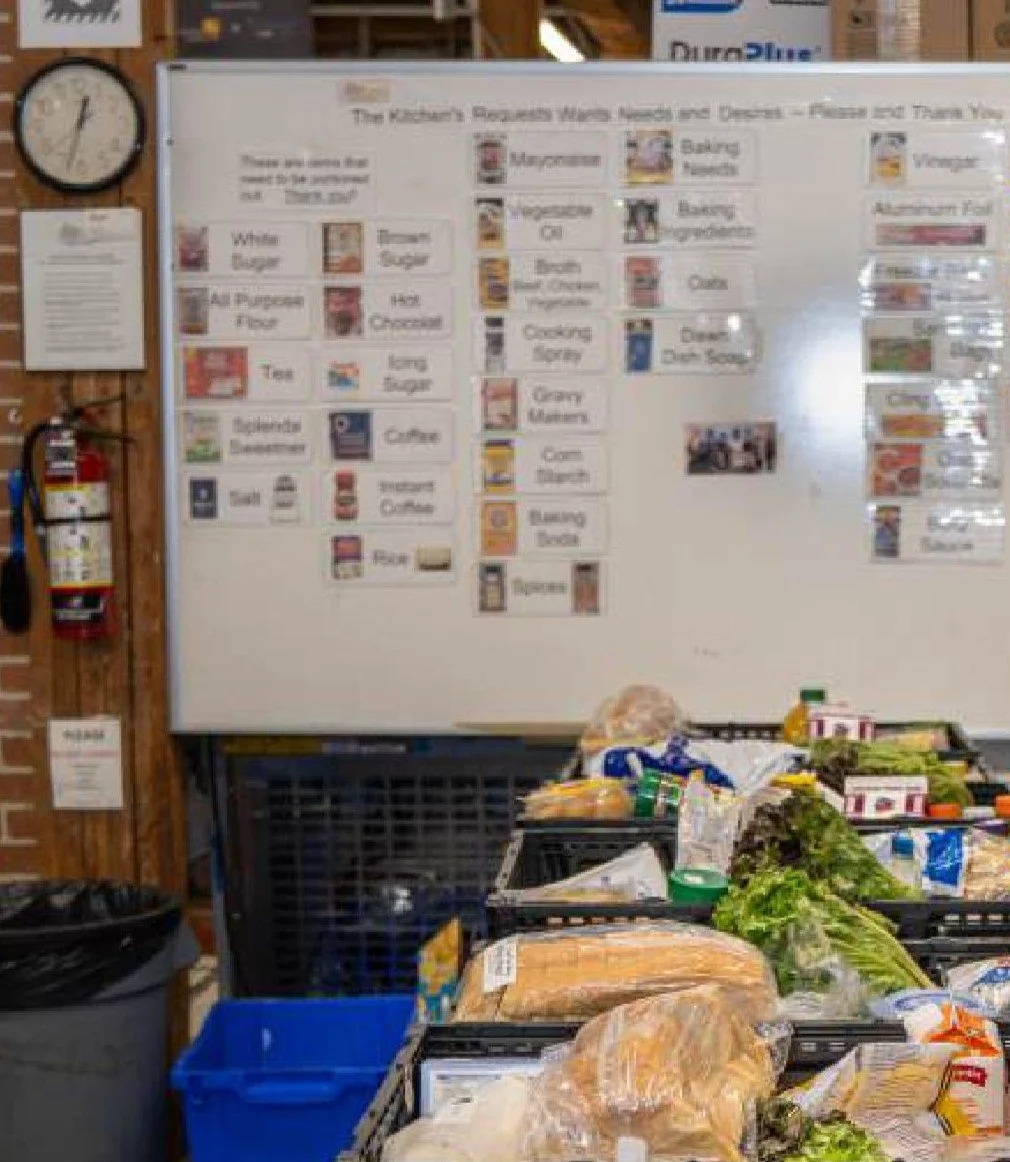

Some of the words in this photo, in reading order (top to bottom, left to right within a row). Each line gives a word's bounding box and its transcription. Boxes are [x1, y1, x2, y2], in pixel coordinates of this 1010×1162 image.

[618, 104, 672, 121] Needs
[679, 105, 711, 121] and
[912, 103, 963, 120] Thank
[682, 138, 740, 156] Baking
[682, 161, 739, 177] Needs
[913, 153, 978, 173] Vinegar
[508, 203, 594, 222] Vegetable
[677, 200, 736, 220] Baking
[231, 230, 280, 247] White
[377, 228, 431, 245] Brown
[231, 253, 282, 273] Sugar
[380, 250, 431, 270] Sugar
[534, 258, 582, 275] Broth
[687, 273, 730, 291] Oats
[210, 291, 231, 306] All
[234, 291, 306, 310] Purpose
[390, 293, 422, 308] Hot
[235, 315, 279, 330] Flour
[523, 323, 593, 344] Cooking
[681, 327, 730, 343] Dawn
[387, 353, 429, 373] Icing
[532, 347, 583, 366] Spray
[261, 363, 295, 382] Tea
[383, 376, 433, 396] Sugar
[532, 385, 584, 406] Gravy
[232, 415, 302, 436] Splenda
[526, 408, 590, 425] Makers
[384, 427, 440, 445] Coffee
[535, 468, 591, 485] Starch
[229, 489, 262, 507] Salt
[379, 499, 437, 516] Coffee
[528, 509, 588, 529] Baking
[536, 531, 581, 548] Soda
[372, 550, 409, 567] Rice
